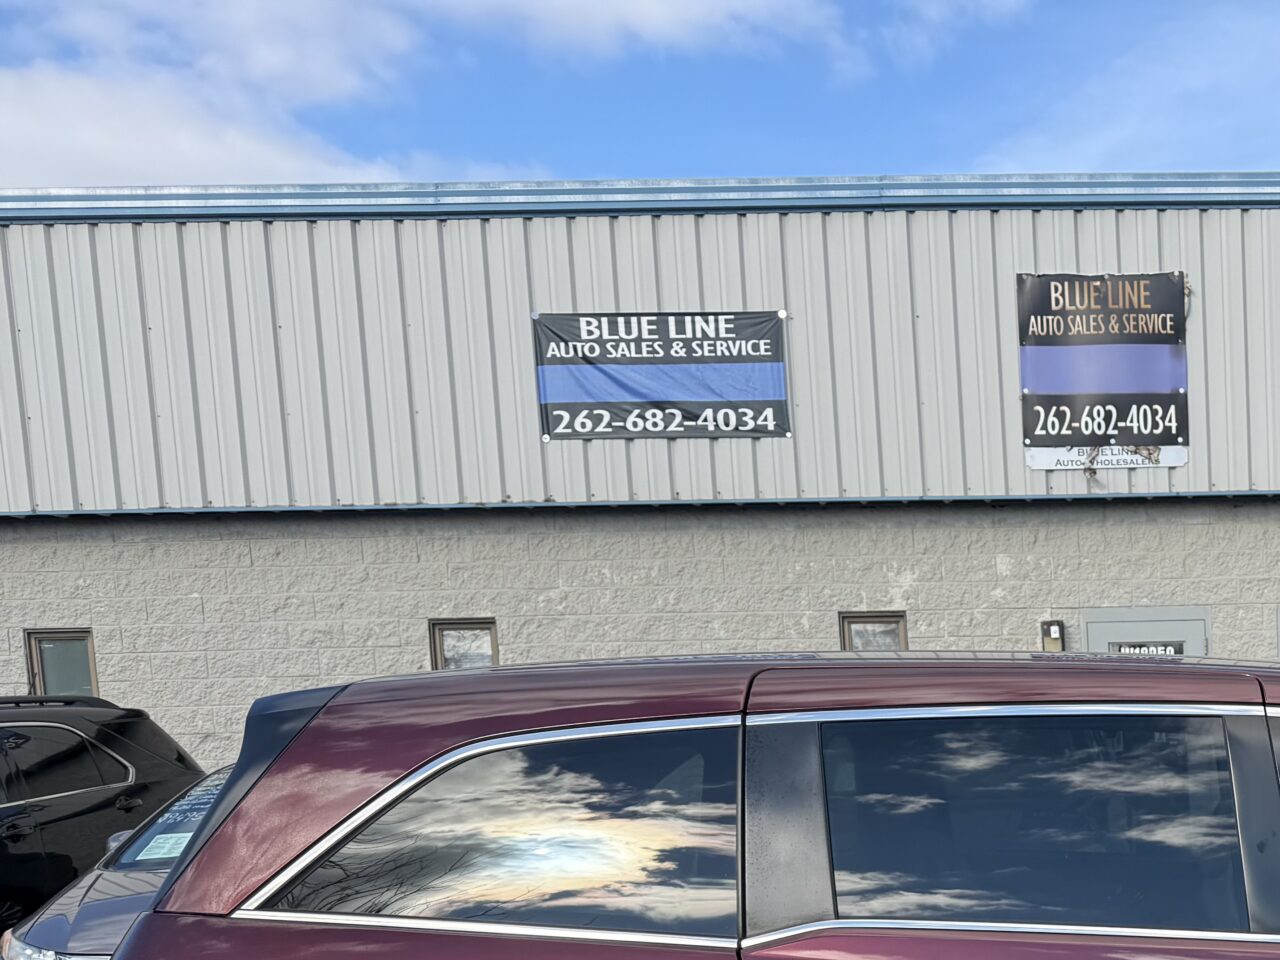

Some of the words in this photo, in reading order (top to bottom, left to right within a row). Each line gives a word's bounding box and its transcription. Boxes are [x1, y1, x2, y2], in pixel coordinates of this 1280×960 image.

[1050, 281, 1101, 311] BLUE
[1107, 280, 1151, 309] LINE
[579, 316, 658, 340] BLUE
[668, 315, 736, 339] LINE
[1028, 315, 1064, 336] AUTO
[1067, 314, 1105, 335] SALES
[1109, 314, 1119, 334] &
[1123, 313, 1175, 334] SERVICE
[546, 341, 600, 358] AUTO
[606, 341, 665, 357] SALES
[670, 341, 687, 357] &
[691, 339, 772, 356] SERVICE
[552, 407, 777, 433] 262-682-4034
[1033, 404, 1178, 435] 262-682-4034
[1078, 448, 1110, 457] BE
